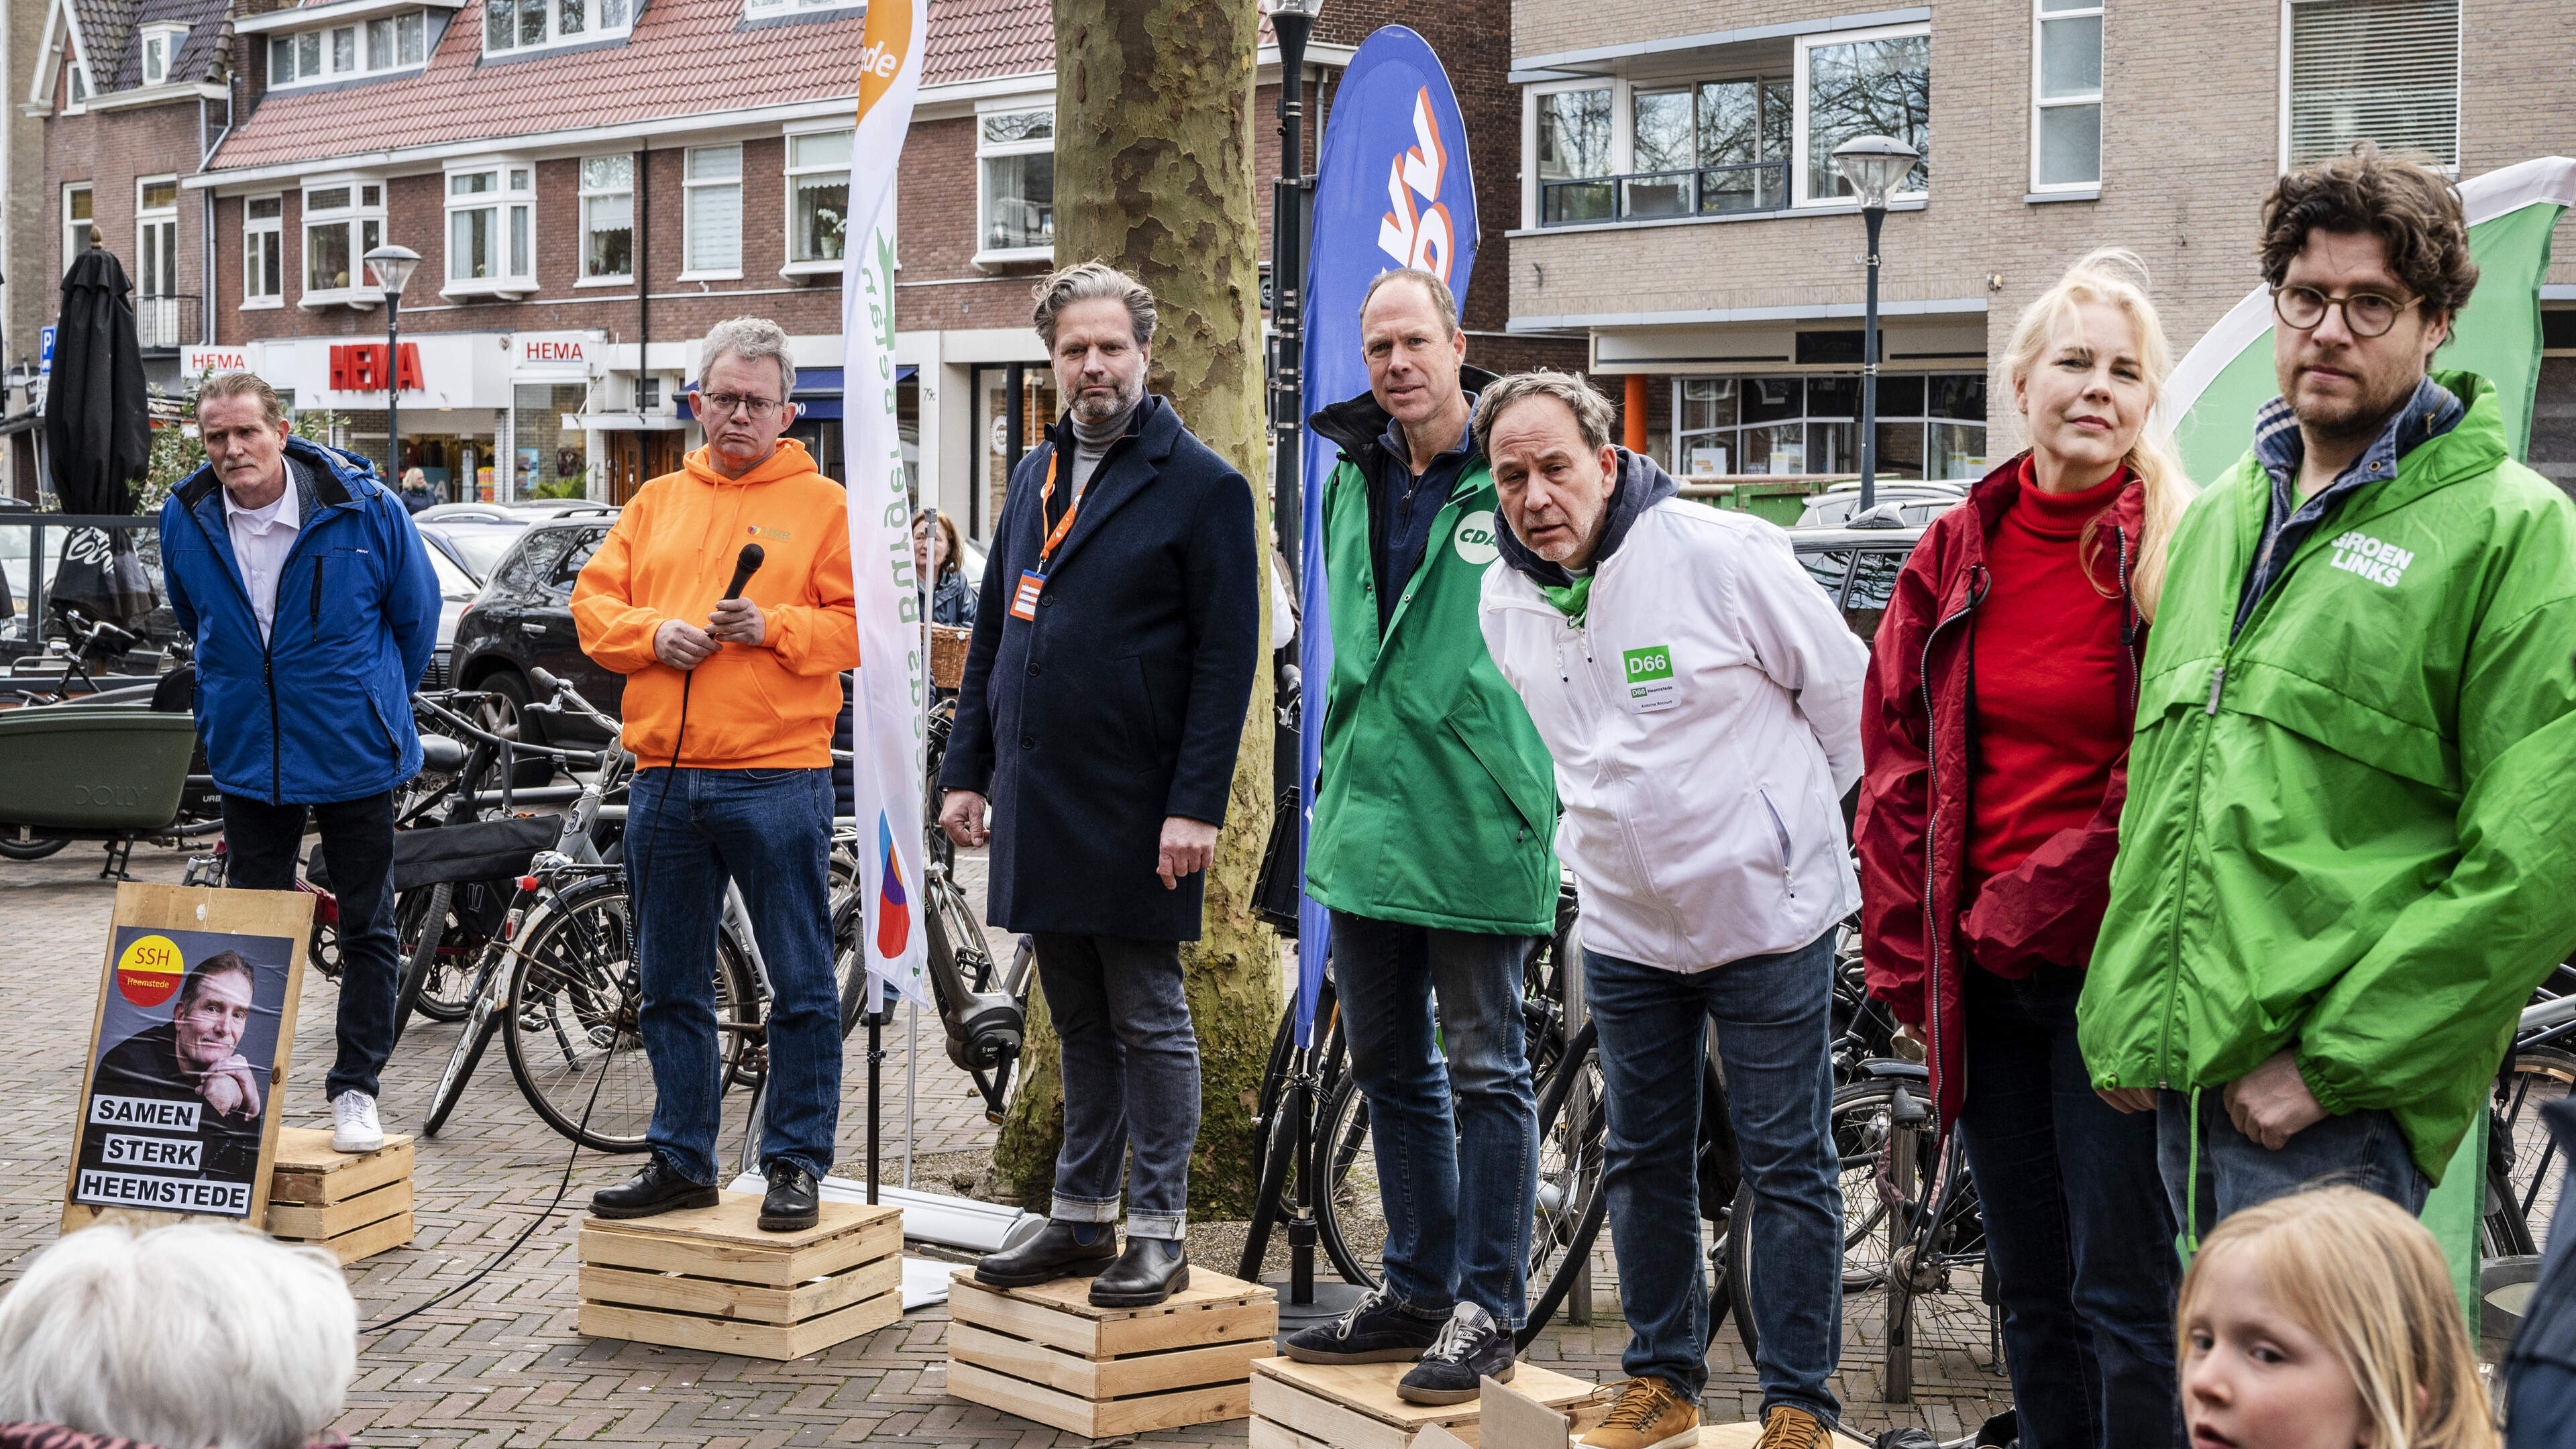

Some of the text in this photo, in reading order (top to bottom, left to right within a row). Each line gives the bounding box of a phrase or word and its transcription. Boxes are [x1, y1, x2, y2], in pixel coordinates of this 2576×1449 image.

[44, 331, 52, 355] P
[527, 342, 583, 360] HEMA
[192, 354, 246, 369] HEMA
[329, 343, 425, 390] HEMA
[1459, 528, 1497, 547] CDA
[2330, 548, 2402, 588] LINKS
[1629, 654, 1666, 674] D66
[1631, 688, 1647, 696] D66
[74, 785, 149, 806] DOLLY
[134, 947, 170, 967] SSH
[127, 977, 170, 988] Heemstede
[98, 1099, 194, 1127] SAMEN
[107, 1138, 199, 1166] STERK
[83, 1174, 246, 1209] HEEMSTEDE
